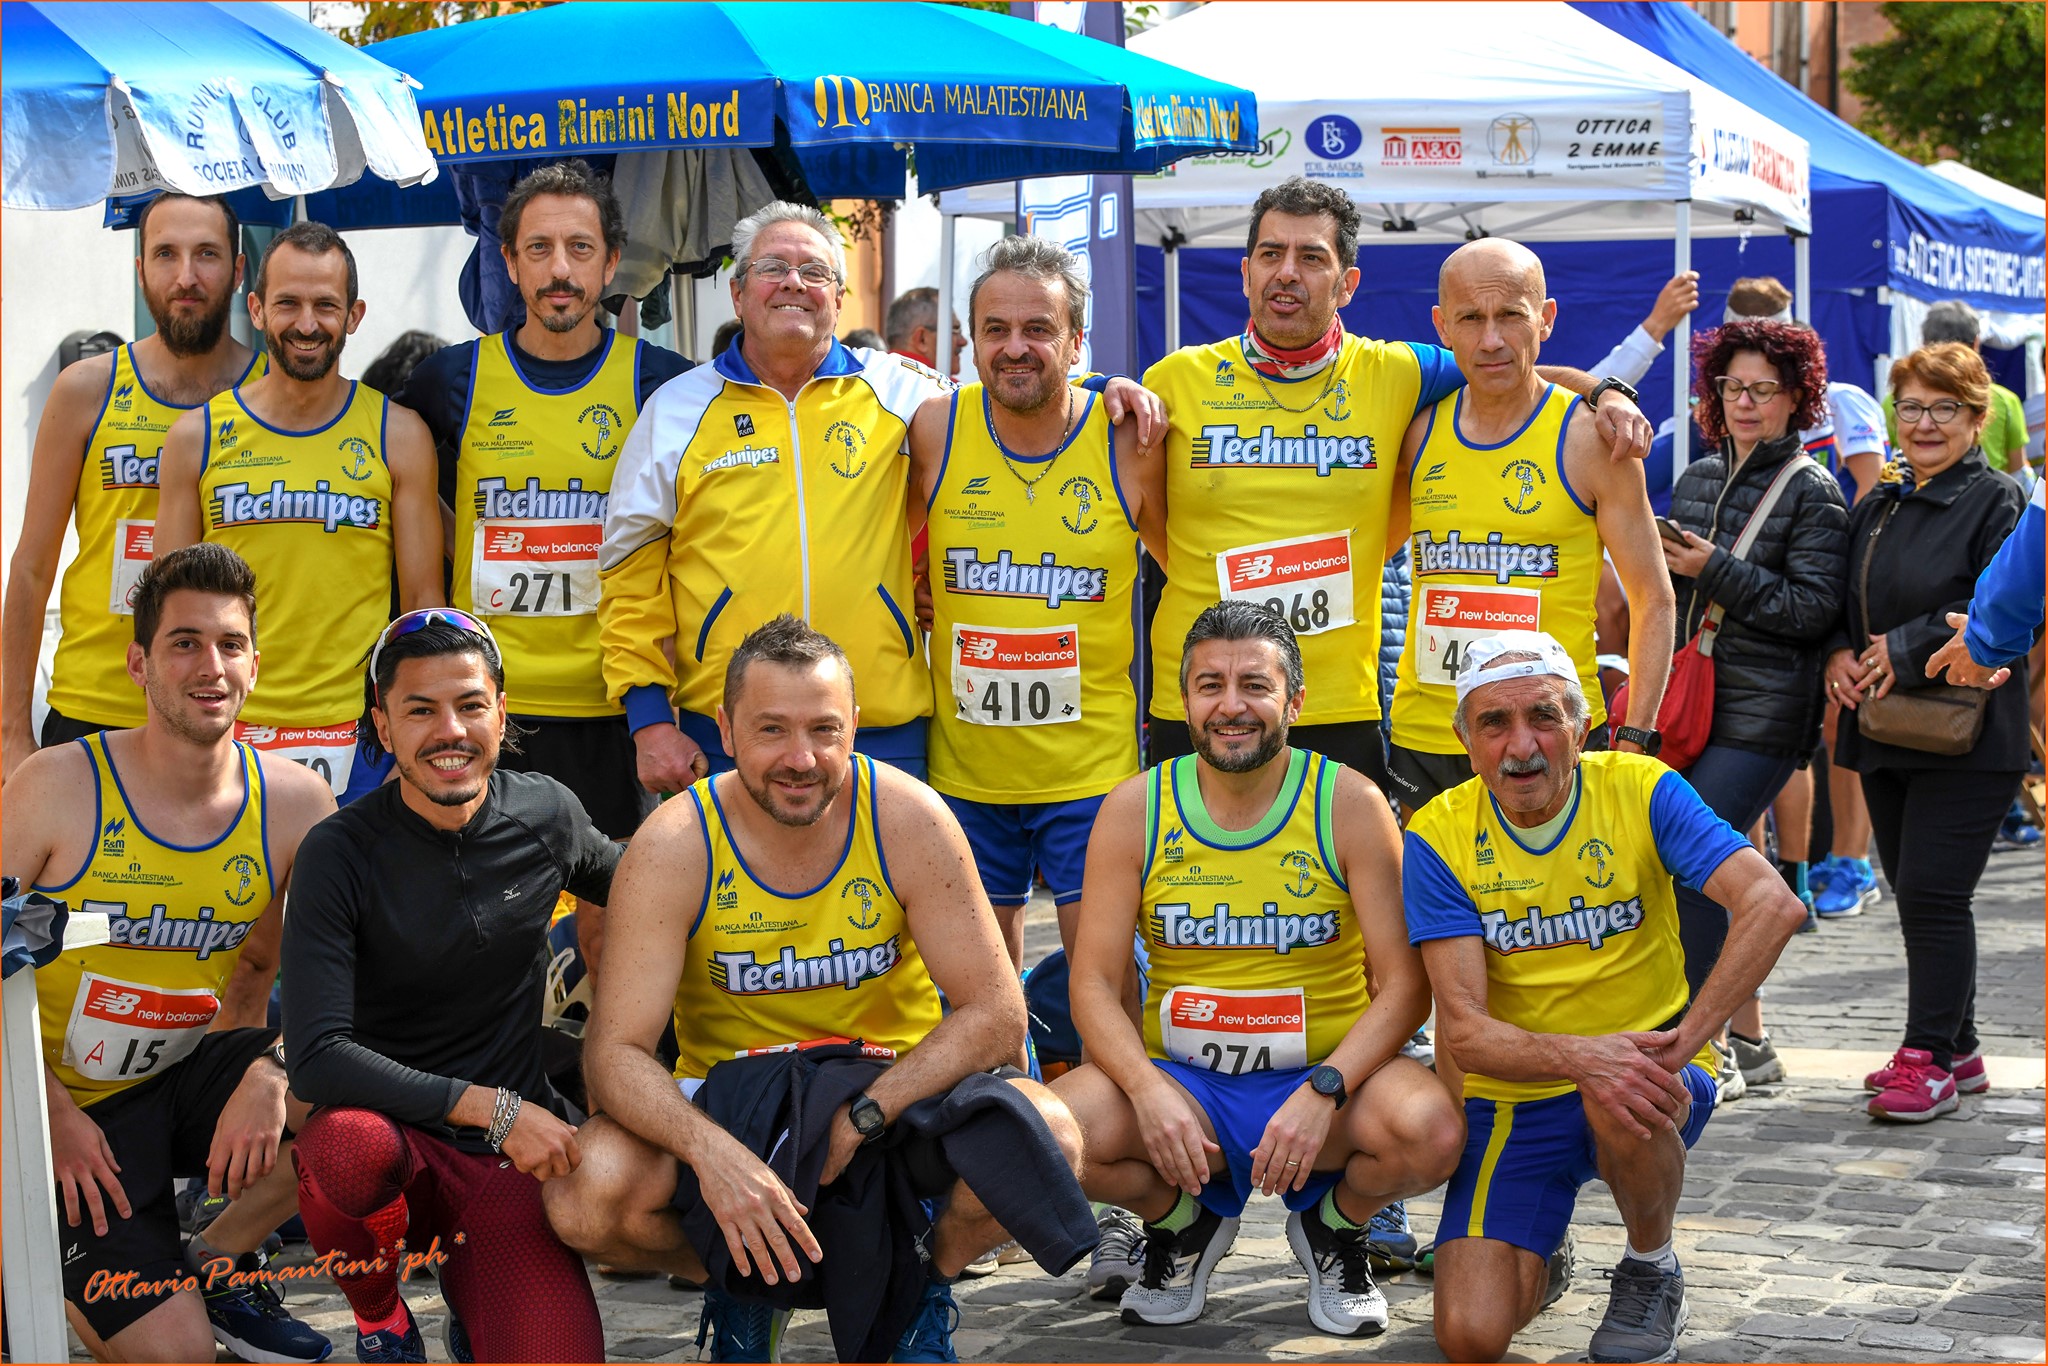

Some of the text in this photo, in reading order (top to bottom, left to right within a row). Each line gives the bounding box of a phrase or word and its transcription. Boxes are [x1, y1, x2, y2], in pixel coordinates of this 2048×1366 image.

[868, 82, 1089, 121] BANCA MALATESTIANA
[251, 85, 297, 150] CLUB
[424, 89, 740, 156] Atletica Rimini Nord
[1170, 94, 1208, 138] Rimini
[1208, 96, 1240, 142] Nord
[1576, 118, 1653, 135] OTTICA
[1411, 141, 1462, 160] A&O
[1568, 141, 1660, 158] 2 EMME
[193, 157, 255, 183] SOCIETÀ
[269, 161, 307, 183] RIMINI
[1908, 230, 1966, 292] ATLETICA
[578, 404, 596, 424] ATLETICA
[612, 411, 623, 428] NORD
[824, 421, 841, 443] ATLETICA
[855, 427, 867, 445] NORD
[234, 455, 284, 465] MALATESTIANA
[581, 442, 618, 461] SANTARCANGELO
[1201, 424, 1372, 477] Technipes
[103, 443, 160, 485] Tec
[829, 460, 867, 480] SANTARCANGELO
[1501, 458, 1546, 485] ATLETICA RIMINI NORD
[1059, 476, 1103, 502] ATLETICA RIMINI NORD
[213, 479, 380, 533] Technipes
[962, 509, 1006, 518] MALATESTIANA
[1503, 496, 1542, 515] SANTARCANGELO
[1061, 515, 1098, 535] SANTARCANGELO
[486, 531, 600, 554] NB new balance
[1232, 554, 1348, 584] NB new balance
[1412, 529, 1553, 585] Technipes
[945, 547, 1105, 610] Technipes
[509, 572, 572, 612] 271
[1427, 595, 1536, 624] NB new balance
[963, 636, 1075, 663] NB new balance
[981, 680, 1051, 722] 410
[280, 731, 304, 741] new
[103, 839, 125, 849] F&M
[1164, 847, 1184, 856] F&M
[222, 854, 239, 872] ATLETICA
[1279, 850, 1296, 868] ATLETICA
[92, 870, 175, 882] BANCA MALATESTIANA
[1157, 875, 1181, 883] BANCA
[1182, 874, 1235, 882] MALATESTIANA
[716, 891, 738, 901] F&M
[841, 878, 856, 899] ATLETICA
[871, 882, 883, 898] NORD
[1284, 882, 1319, 899] SANTARCANGELO
[714, 922, 741, 932] BANCA
[742, 919, 799, 930] MALATESTIANA
[847, 912, 882, 931] SANTARCANGELO
[1154, 901, 1335, 955] Technipes
[1481, 895, 1643, 955] Technipes
[713, 937, 899, 993] Technipes
[88, 988, 214, 1023] NB new balance
[1174, 997, 1301, 1025] NB new balance
[84, 1038, 167, 1077] A 15
[1200, 1042, 1275, 1076] 274
[363, 1336, 379, 1348] NIKE
